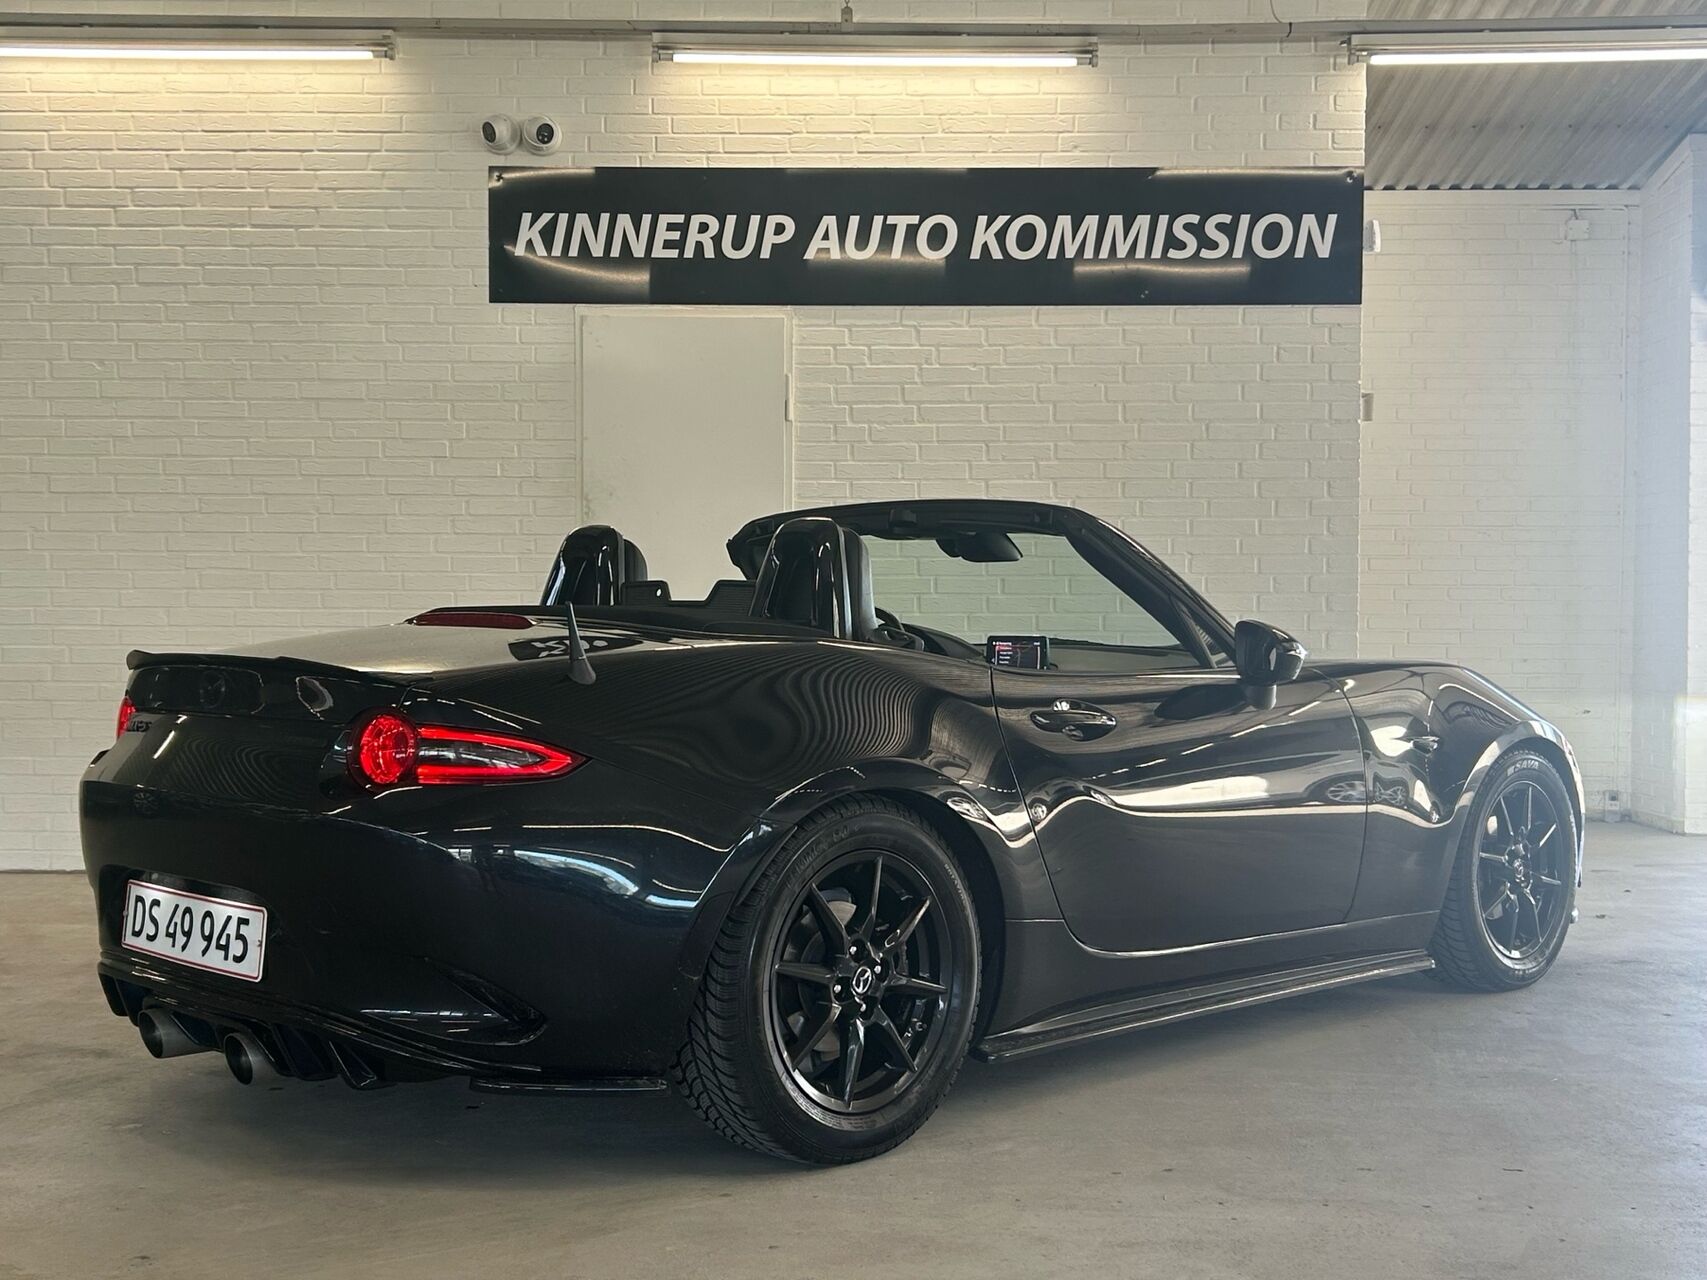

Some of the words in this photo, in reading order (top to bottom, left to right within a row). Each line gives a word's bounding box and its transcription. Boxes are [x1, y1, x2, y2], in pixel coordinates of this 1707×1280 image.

[514, 212, 796, 260] KINNERUP
[804, 214, 958, 261] AUTO
[969, 213, 1338, 260] KOMMISSION
[1515, 759, 1539, 771] SAVA
[131, 894, 161, 942] DS
[165, 903, 194, 953] 49
[200, 910, 250, 964] 945
